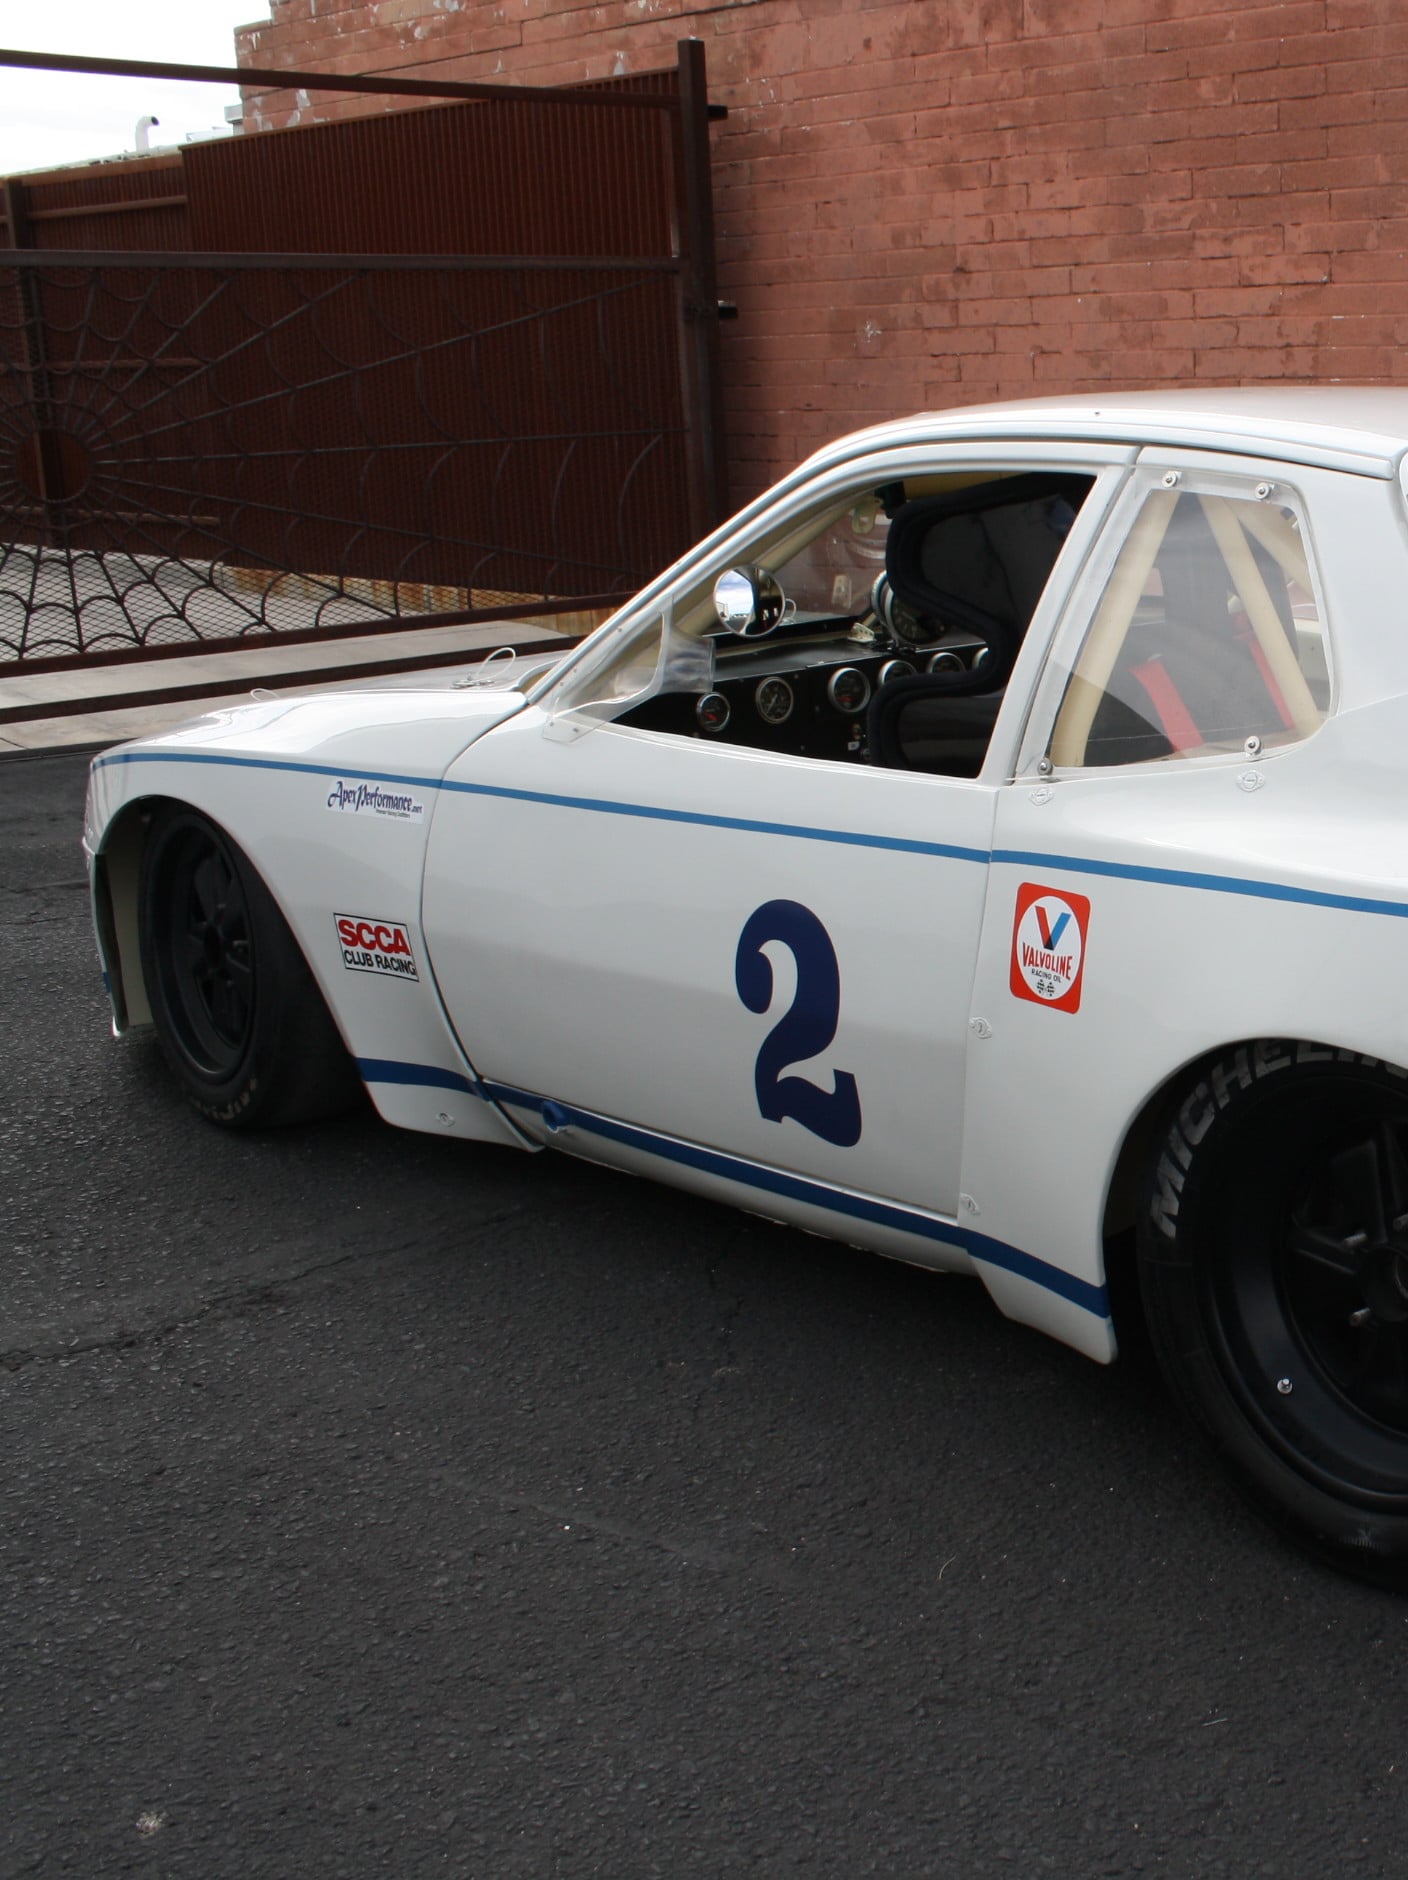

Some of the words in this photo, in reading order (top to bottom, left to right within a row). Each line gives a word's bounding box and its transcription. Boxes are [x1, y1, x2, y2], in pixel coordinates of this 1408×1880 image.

[338, 919, 411, 957] SCCA
[344, 949, 374, 967] CLUB
[375, 954, 417, 975] RACING
[1023, 941, 1073, 981] VALVOLINE
[1031, 968, 1052, 980] RACING
[1053, 973, 1062, 984] OIL
[735, 899, 862, 1148] 2
